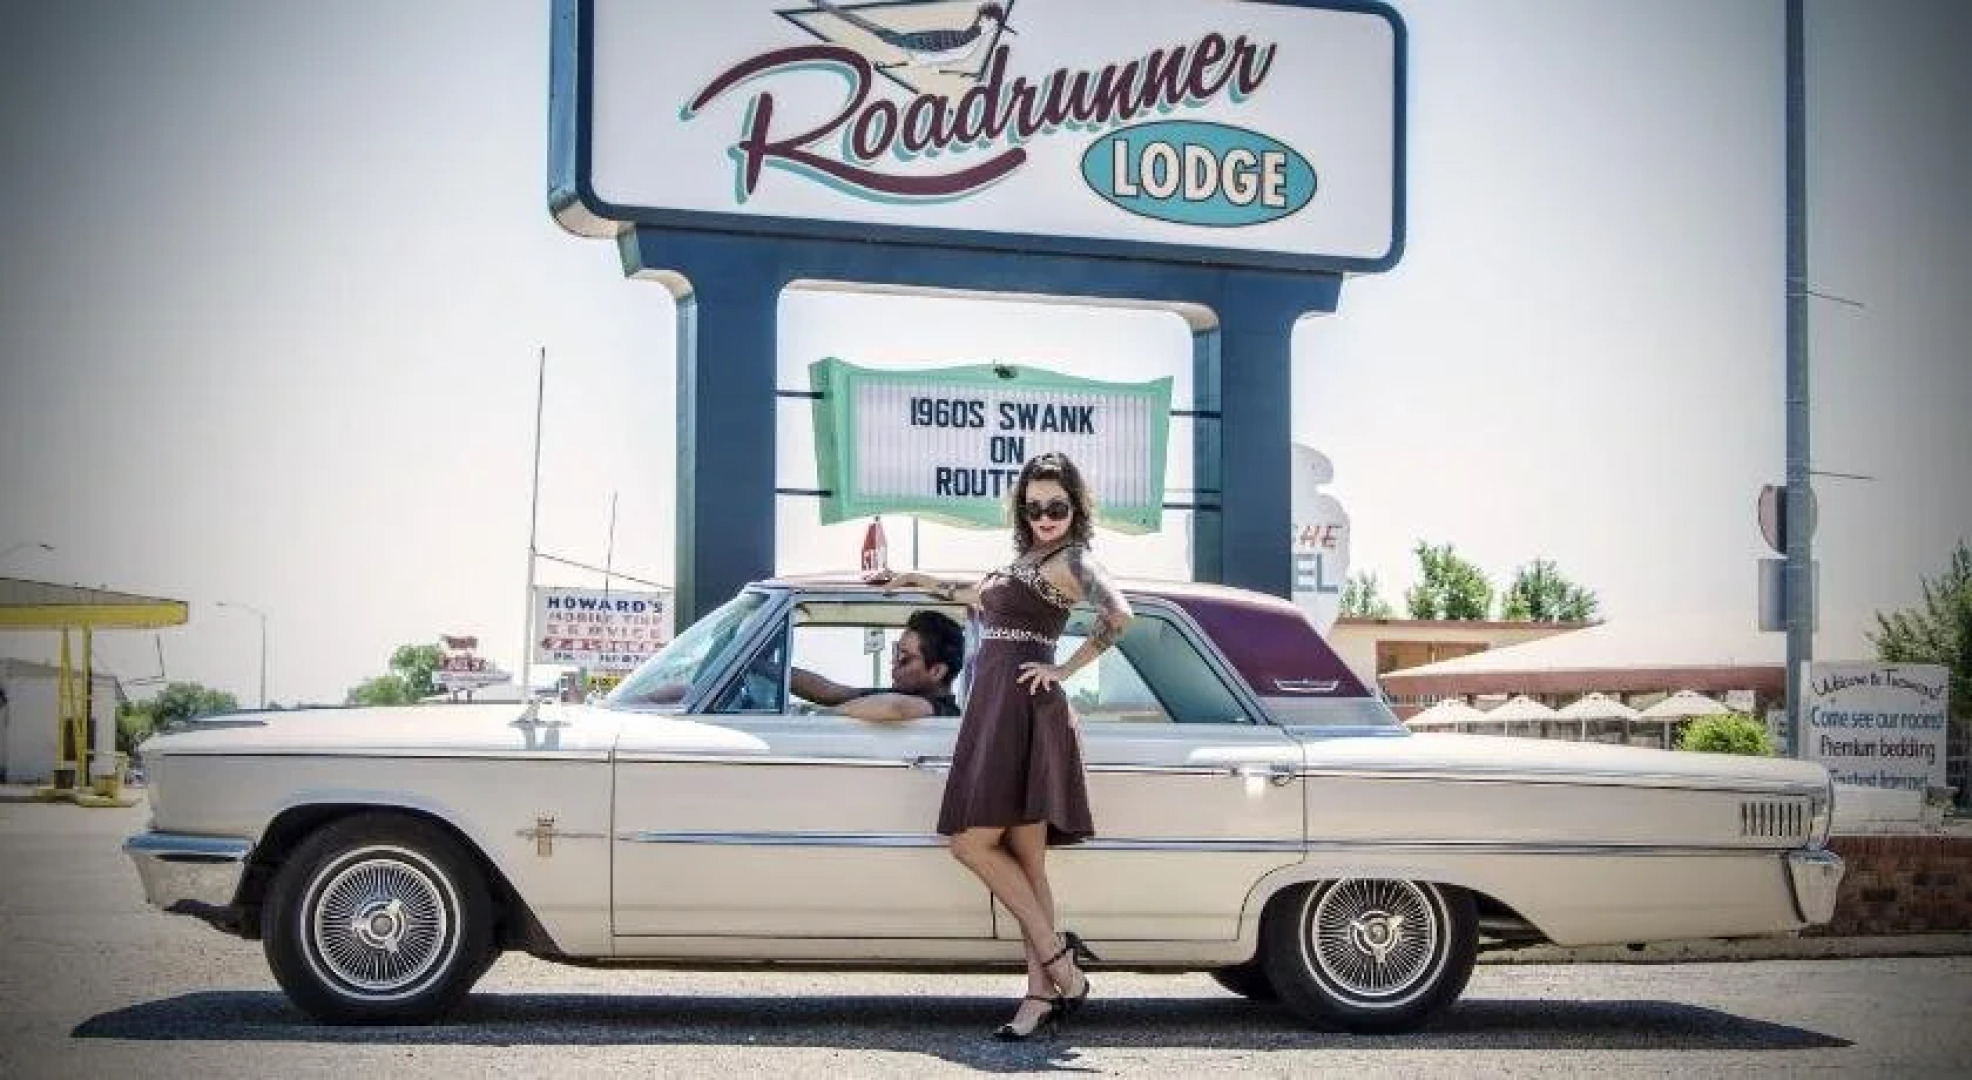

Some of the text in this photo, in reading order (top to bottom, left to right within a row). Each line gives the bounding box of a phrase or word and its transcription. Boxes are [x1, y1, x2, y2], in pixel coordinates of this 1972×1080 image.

[680, 32, 1278, 204] Roadrunner
[1113, 138, 1288, 209] LODGE
[910, 397, 1095, 435] 1960S SWANK
[990, 436, 1025, 463] ON
[1291, 525, 1344, 548] HE
[547, 596, 663, 614] HOWARD'S
[1811, 706, 1850, 728] Come
[1852, 713, 1874, 728] see
[1876, 713, 1900, 728] our
[1821, 734, 1935, 766] Premium bedding
